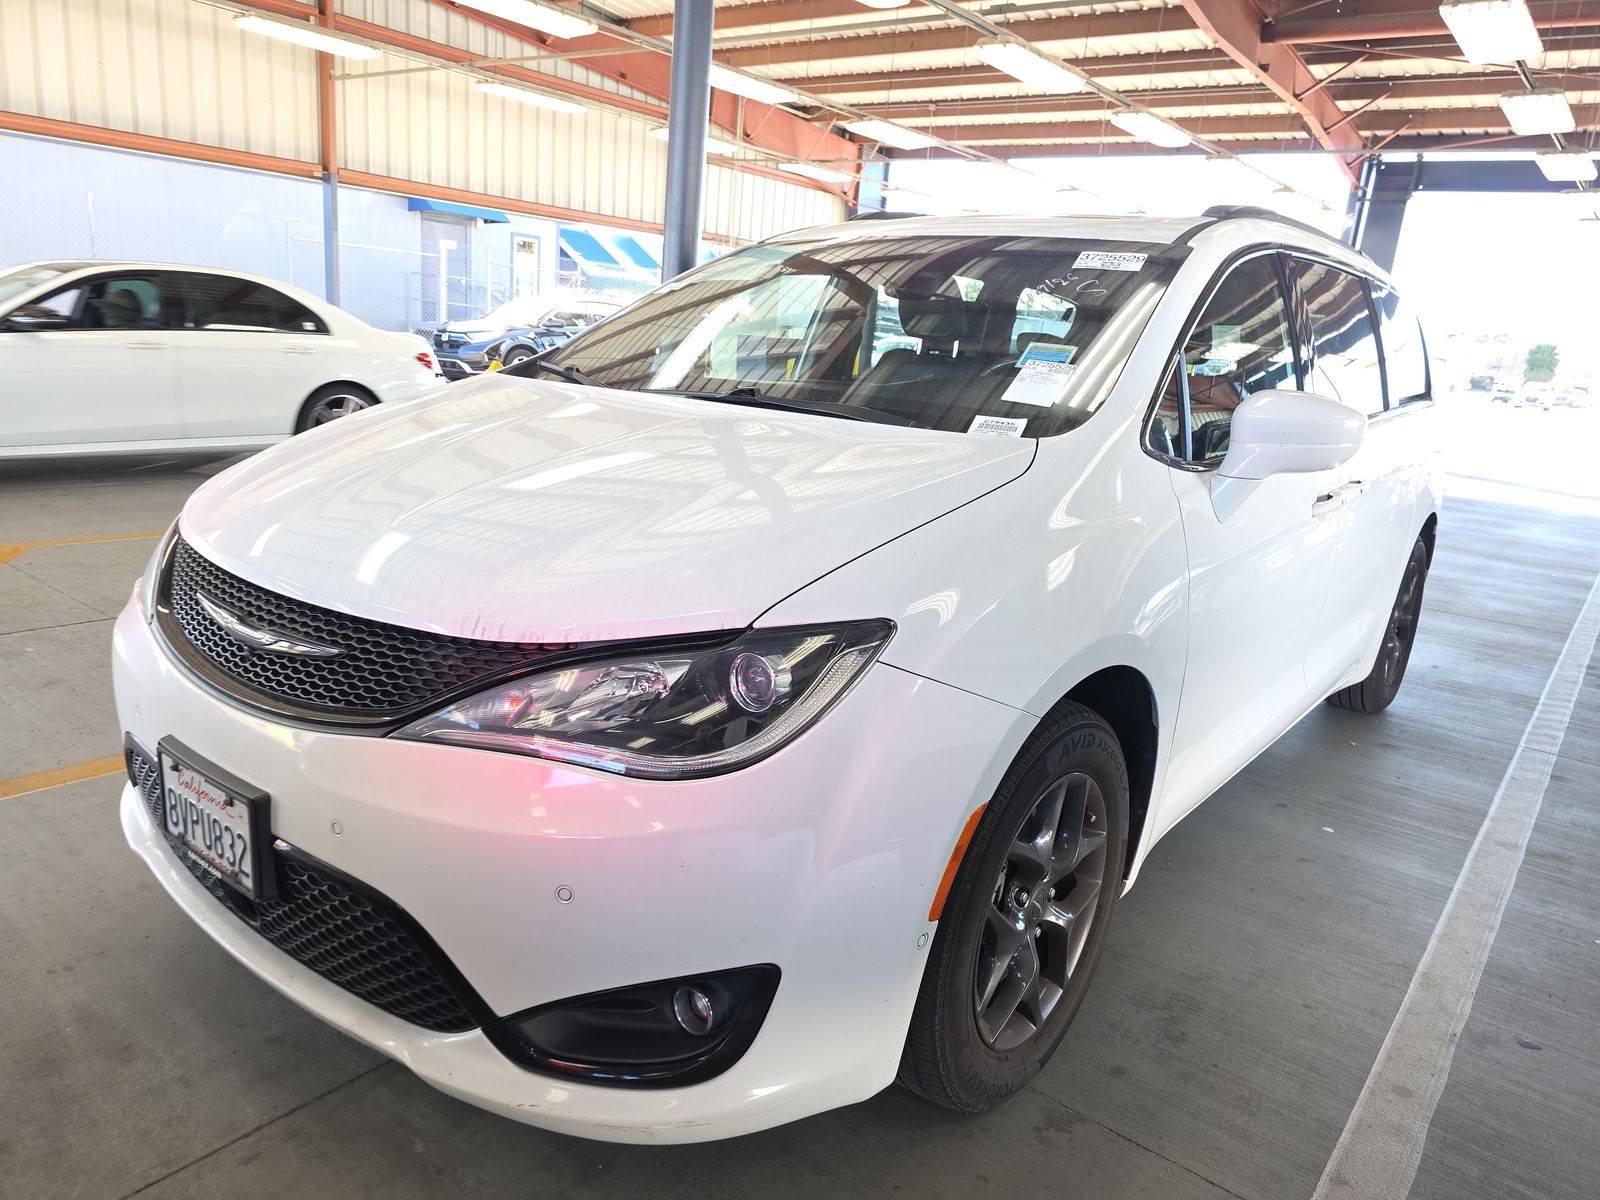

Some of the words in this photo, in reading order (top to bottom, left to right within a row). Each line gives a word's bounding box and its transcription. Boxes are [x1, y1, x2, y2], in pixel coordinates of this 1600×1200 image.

[1080, 253, 1146, 263] 3725529
[1028, 360, 1076, 371] 3725529
[1058, 732, 1096, 764] AVID
[1096, 737, 1122, 769] Ascend
